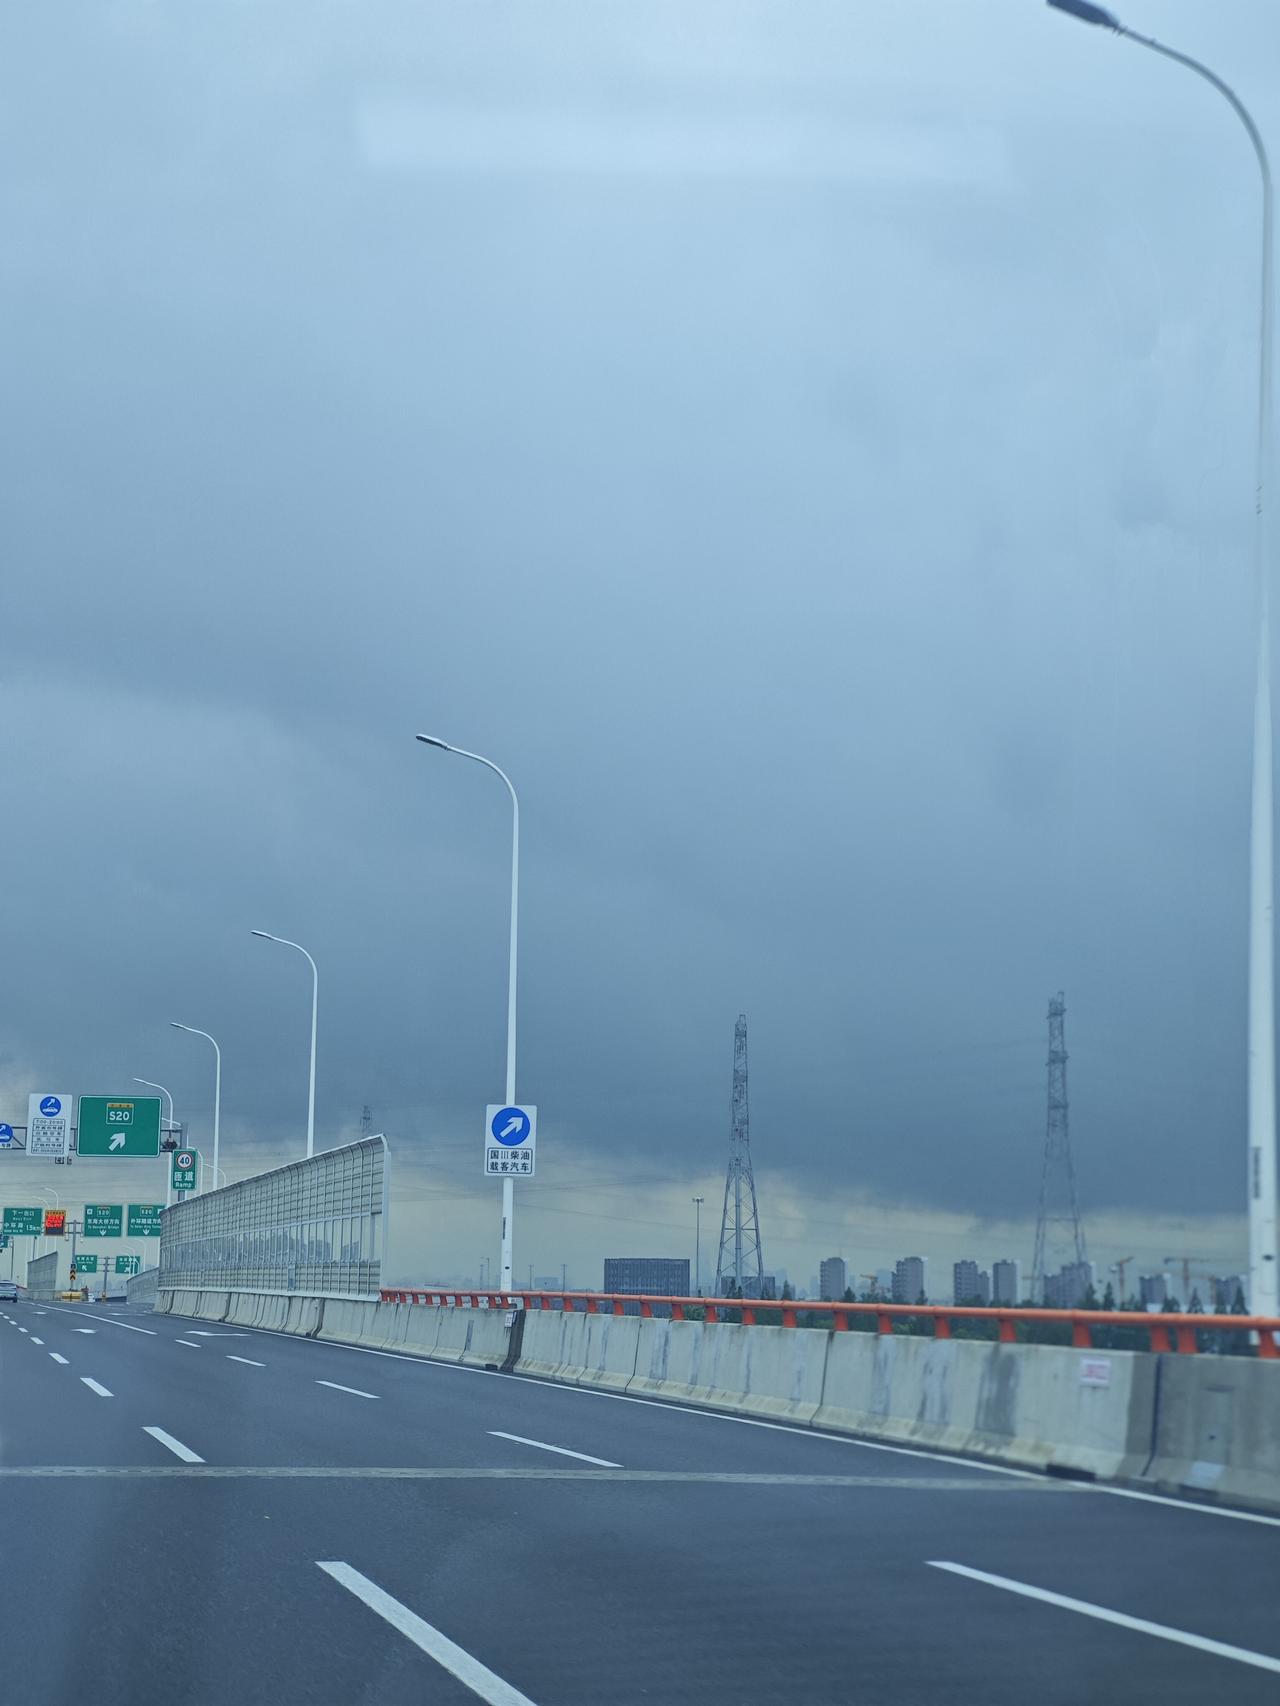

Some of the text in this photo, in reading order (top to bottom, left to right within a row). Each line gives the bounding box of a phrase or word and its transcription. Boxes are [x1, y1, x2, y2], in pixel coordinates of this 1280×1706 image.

[109, 1111, 130, 1121] S20
[180, 1157, 190, 1165] 40
[490, 1161, 530, 1172] 载客汽车
[175, 1171, 194, 1181] 匝道
